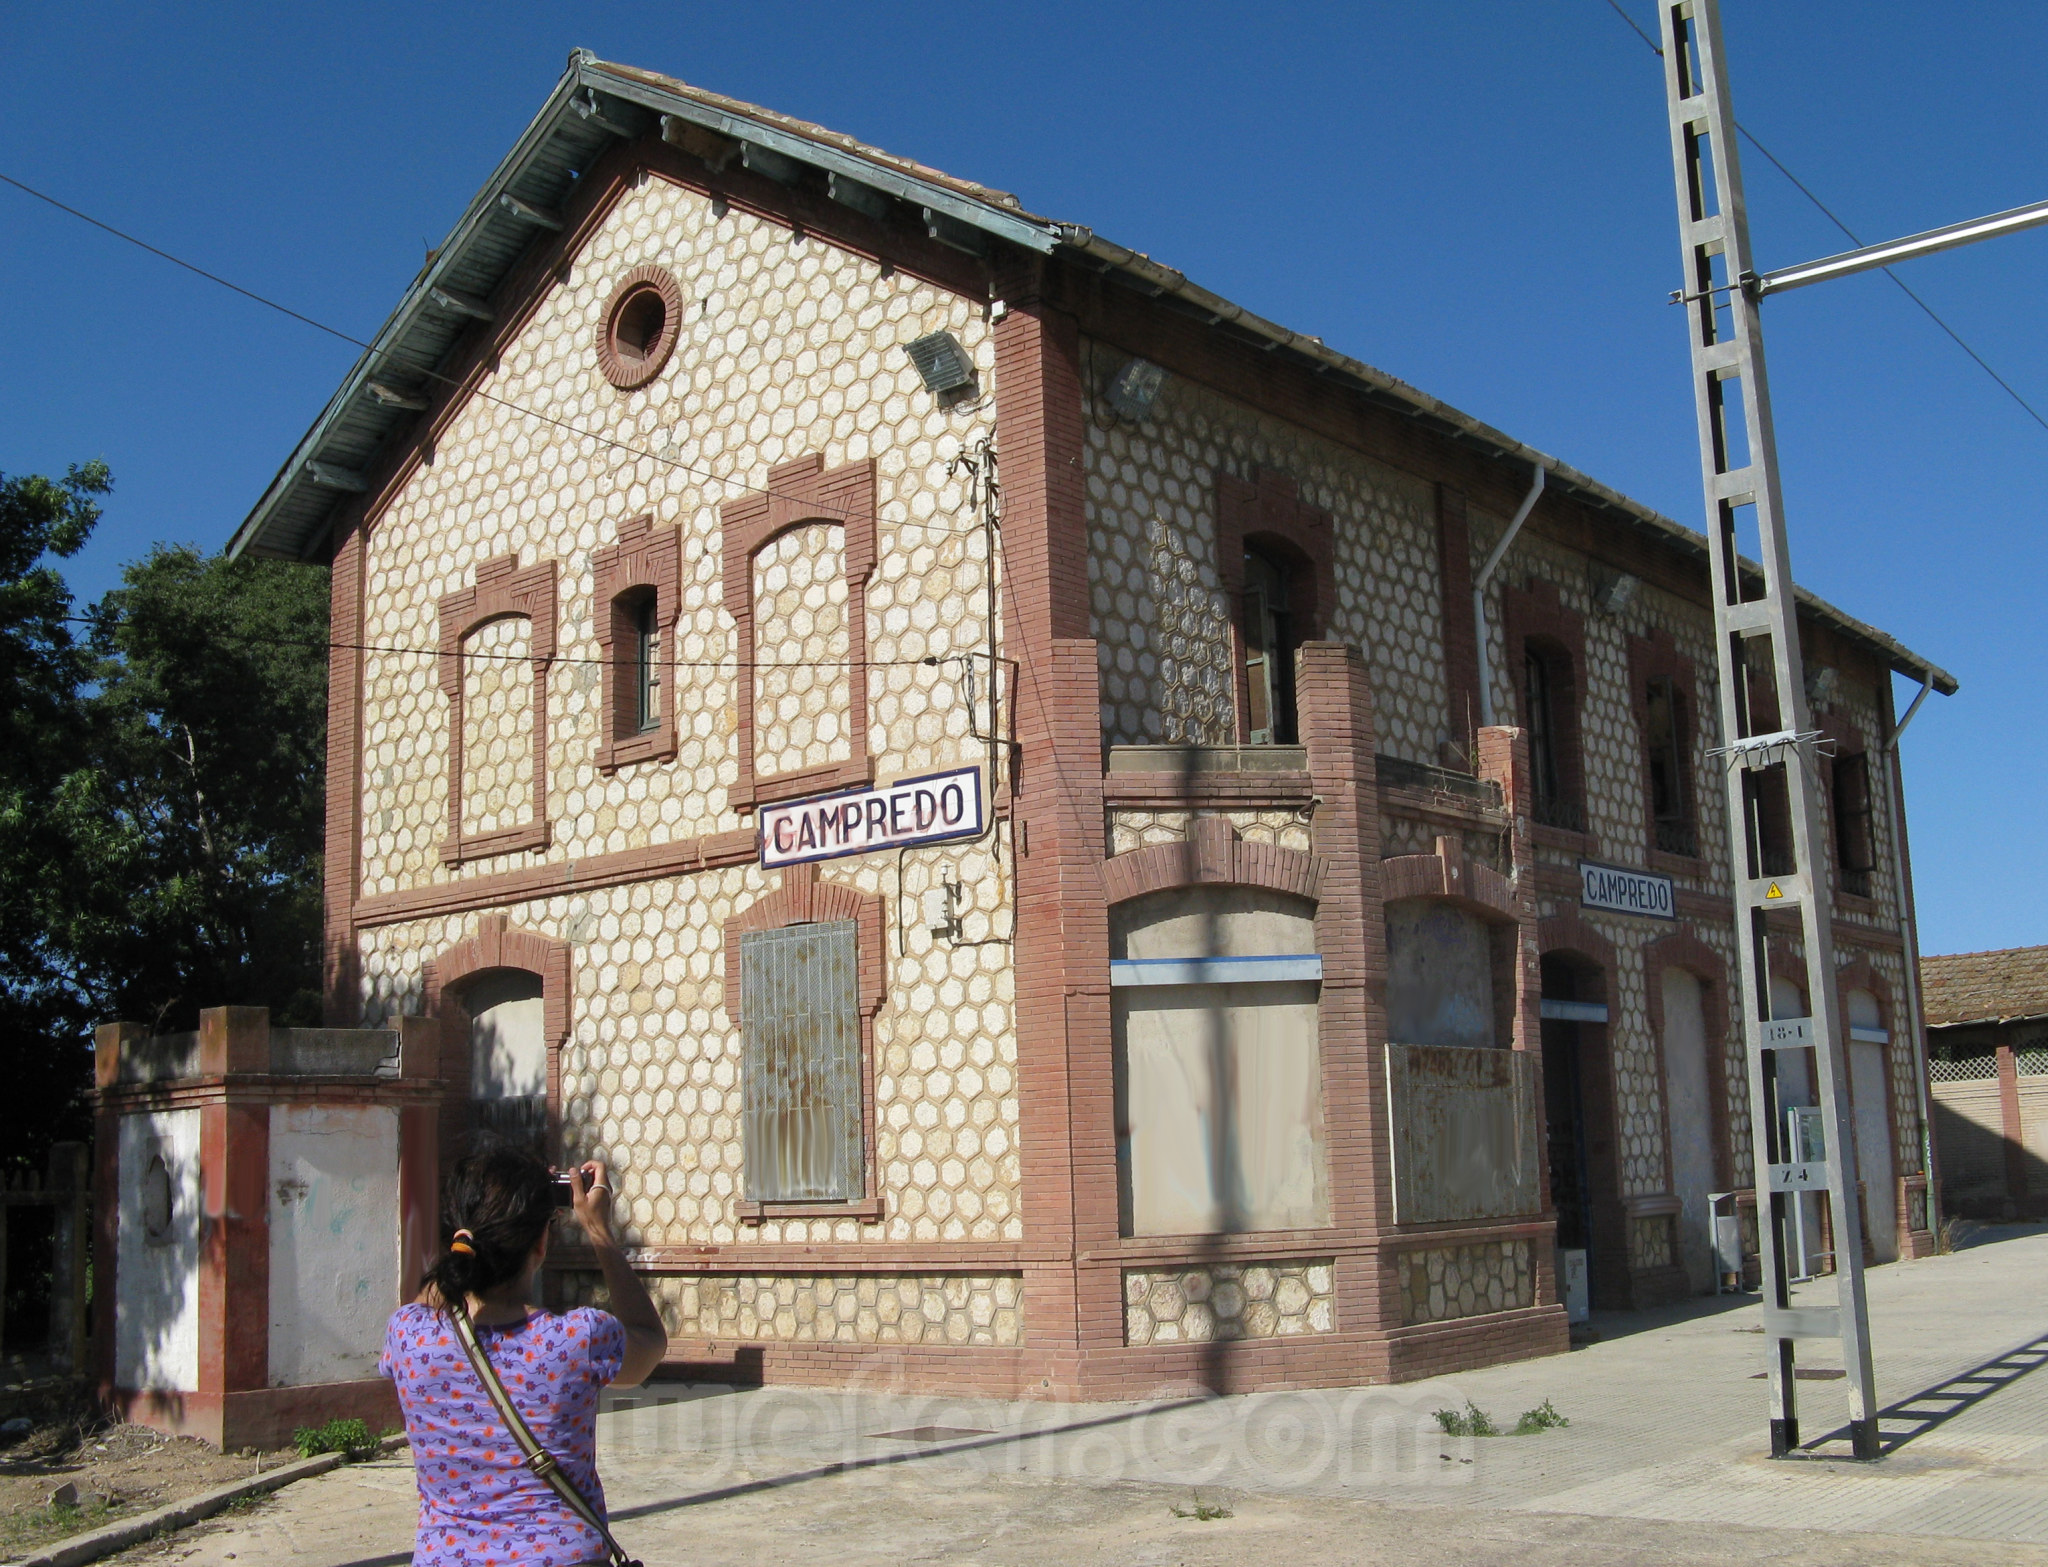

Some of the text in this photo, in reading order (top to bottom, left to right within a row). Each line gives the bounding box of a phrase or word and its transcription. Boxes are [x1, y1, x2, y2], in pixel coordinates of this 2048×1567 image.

[773, 777, 965, 854] CAMPREDÓ
[1586, 869, 1668, 911] CAMPREDÓ
[1798, 1169, 1808, 1181] 4
